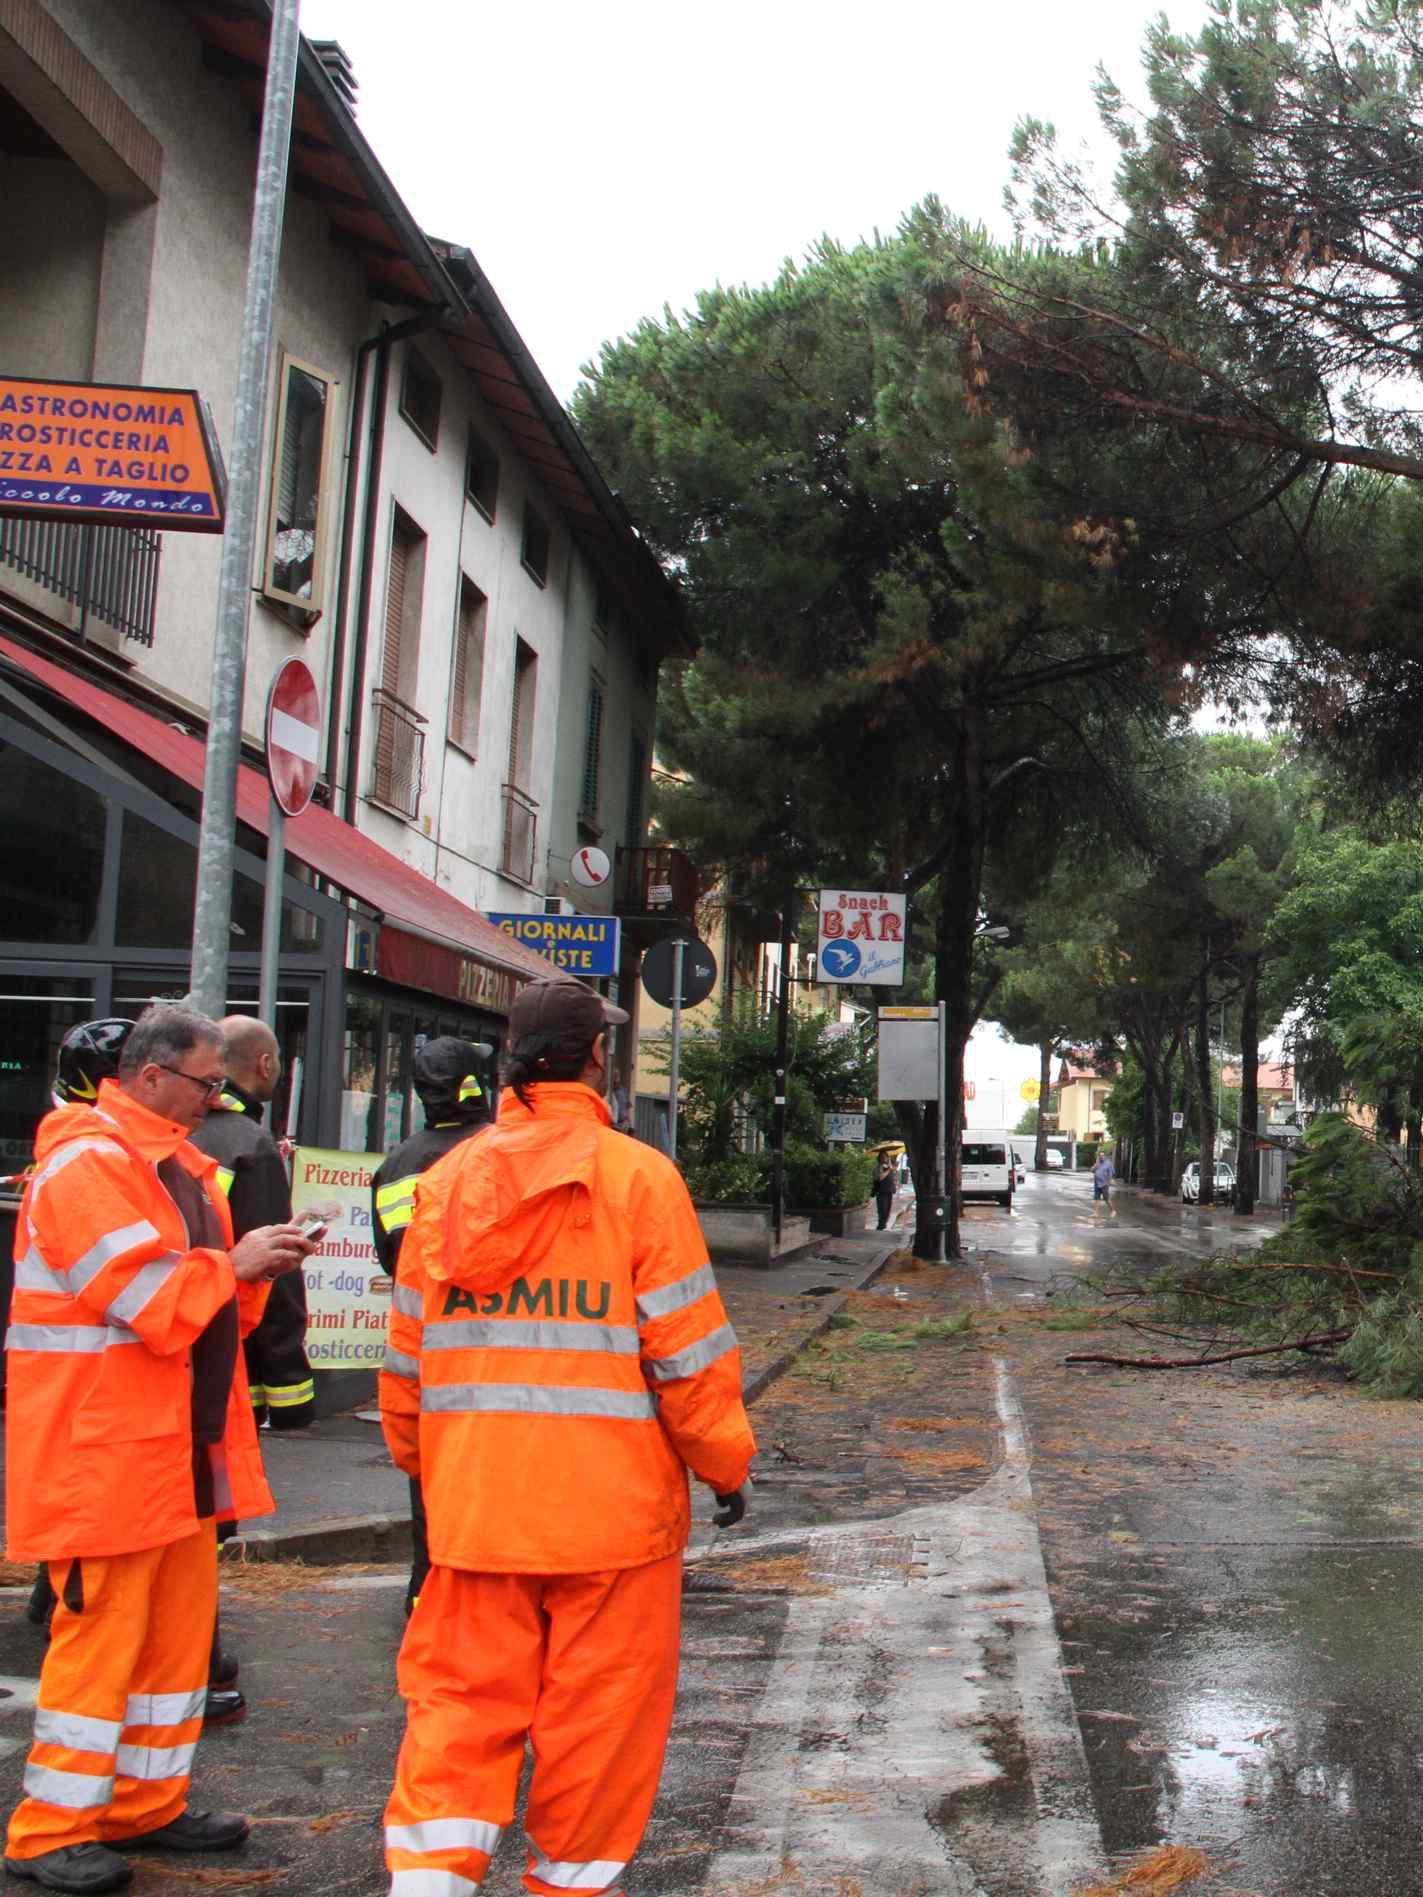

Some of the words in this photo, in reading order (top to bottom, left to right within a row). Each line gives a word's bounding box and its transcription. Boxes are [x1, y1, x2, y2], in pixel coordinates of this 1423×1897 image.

[0, 423, 170, 453] ROSTICCERIA
[64, 456, 82, 475] A
[95, 458, 191, 483] TAGLIO
[101, 489, 203, 513] Mondo
[499, 919, 606, 942] GIORNALI
[822, 910, 903, 942] BAR
[547, 939, 557, 949] e
[304, 1163, 373, 1188] Pizzeria
[314, 1237, 379, 1264] amburg
[304, 1269, 323, 1290] ot
[442, 1276, 612, 1320] ASMIU
[305, 1309, 346, 1329] rimi
[304, 1339, 385, 1360] osticceri
